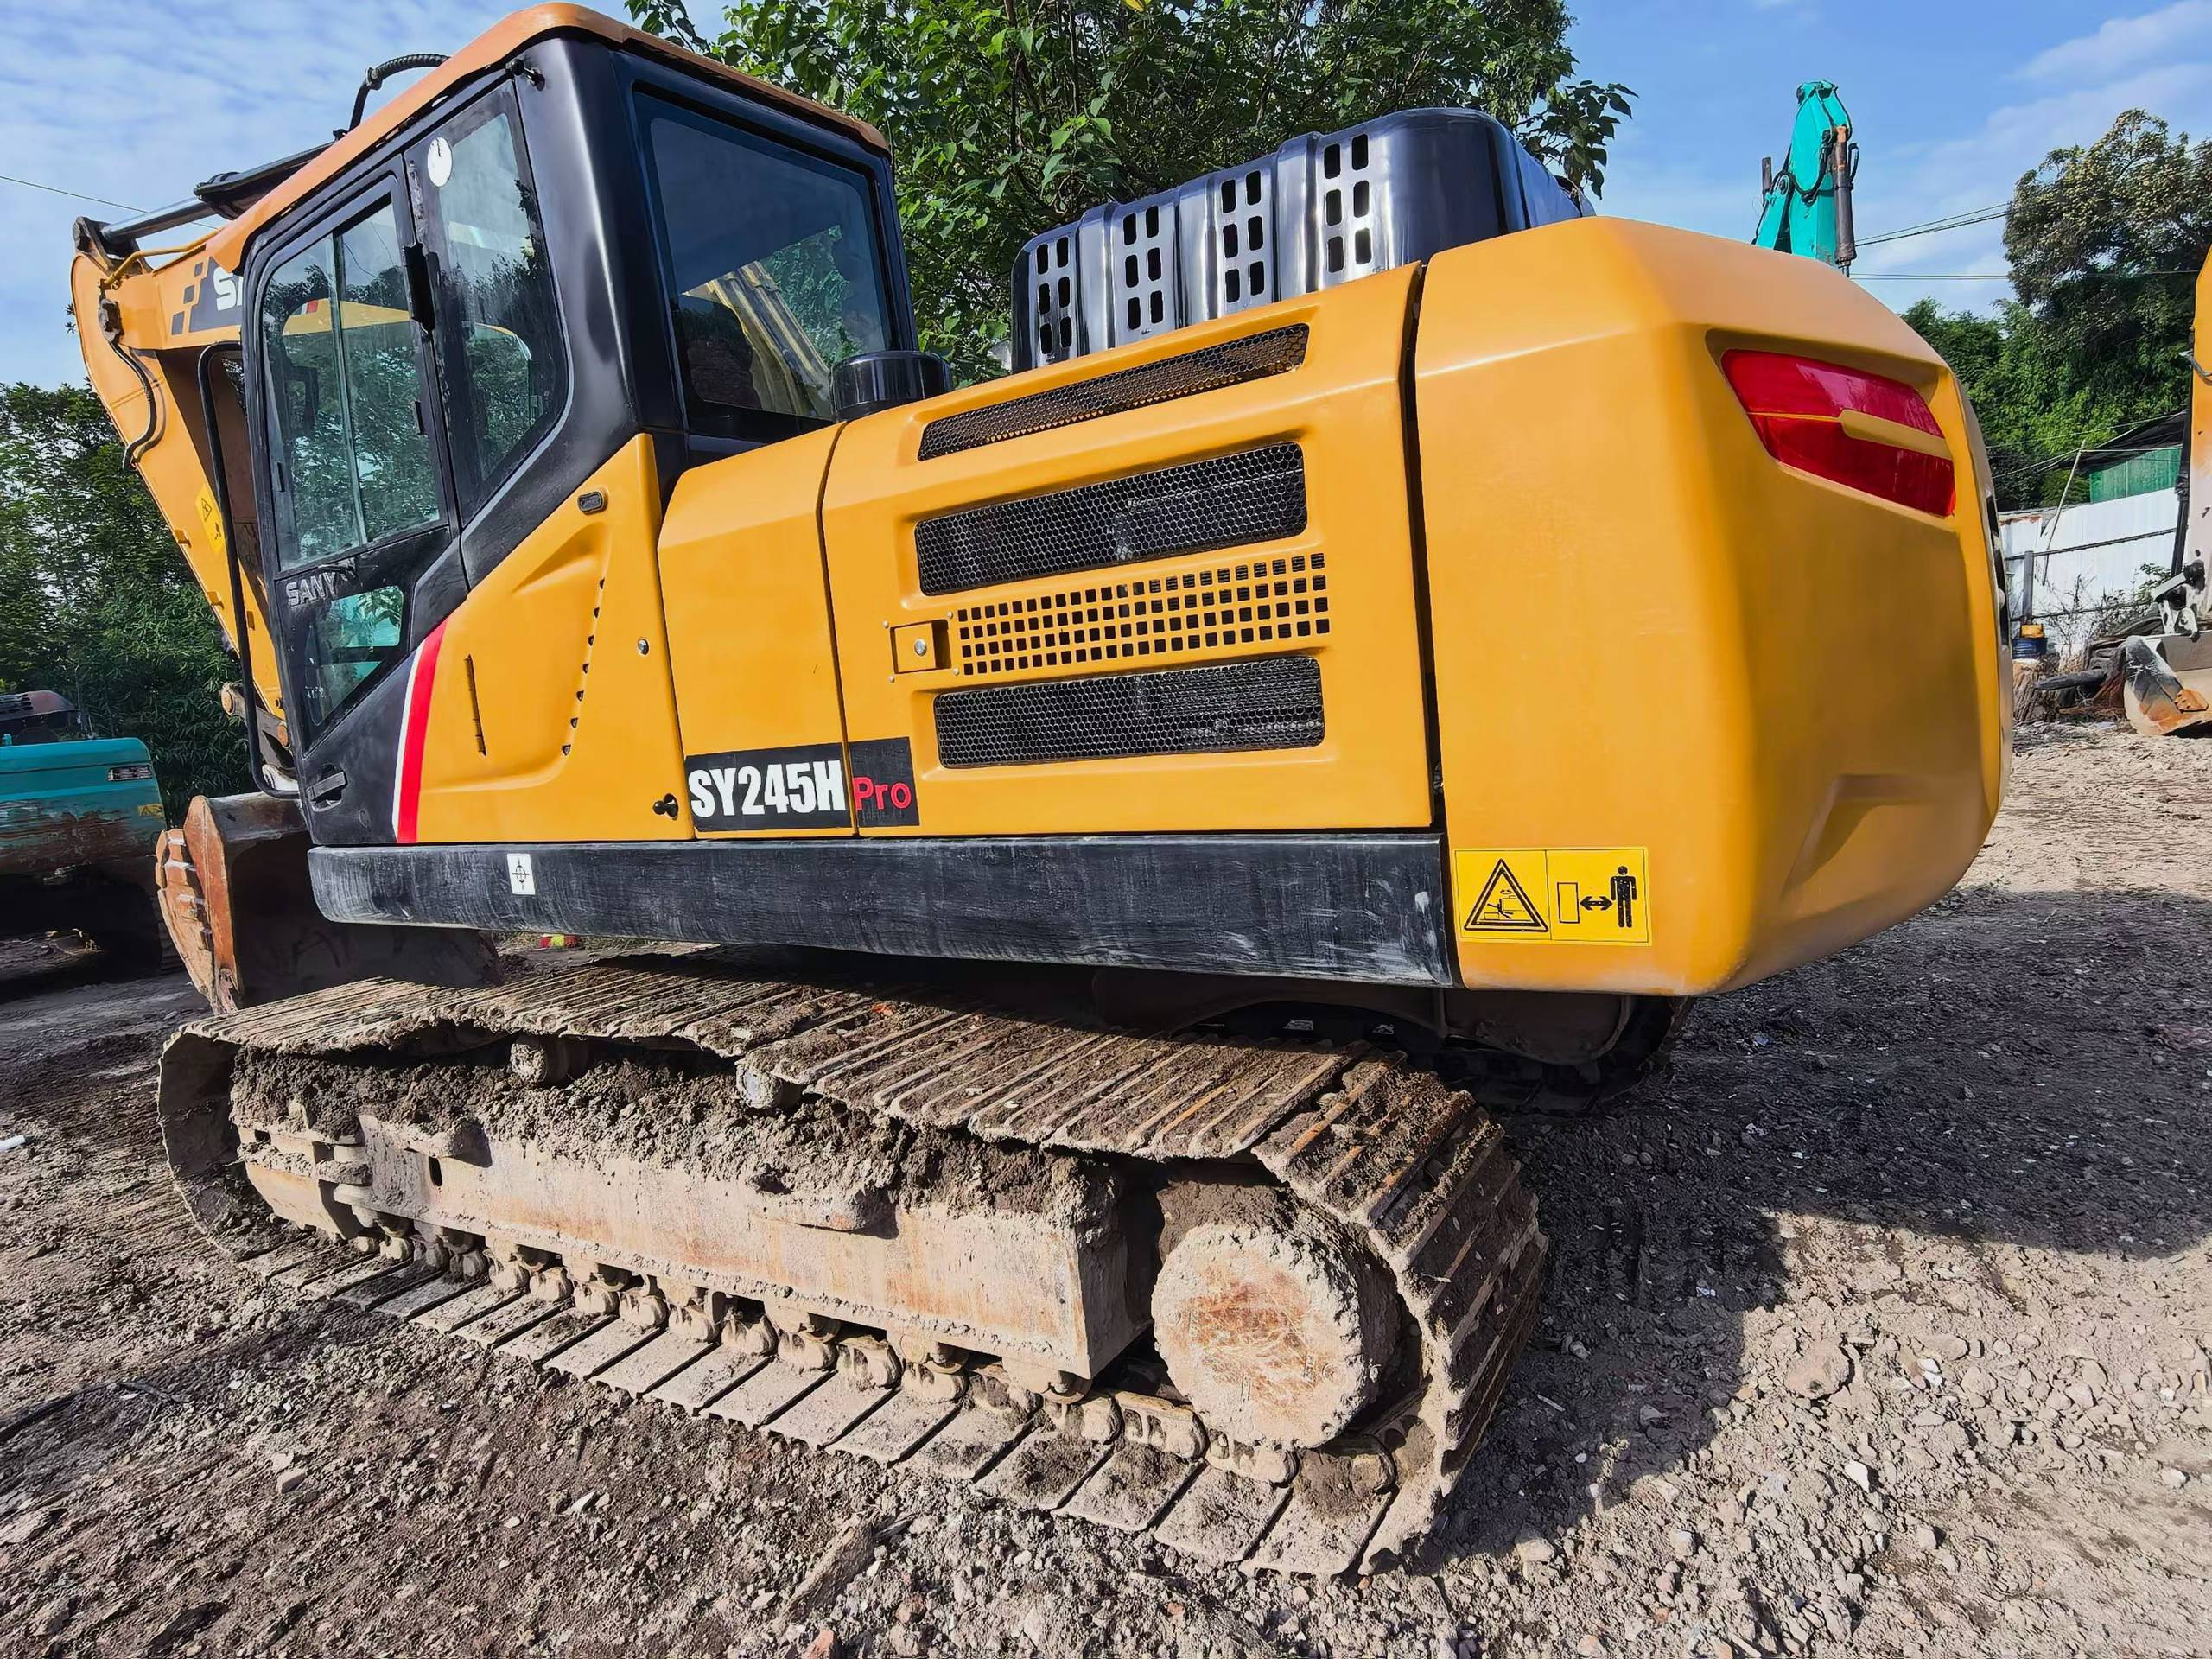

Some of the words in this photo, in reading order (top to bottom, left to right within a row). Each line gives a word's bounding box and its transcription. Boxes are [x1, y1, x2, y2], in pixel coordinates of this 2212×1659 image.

[285, 571, 336, 608] SANY
[688, 760, 847, 818] SY245H
[852, 776, 912, 810] Pro
